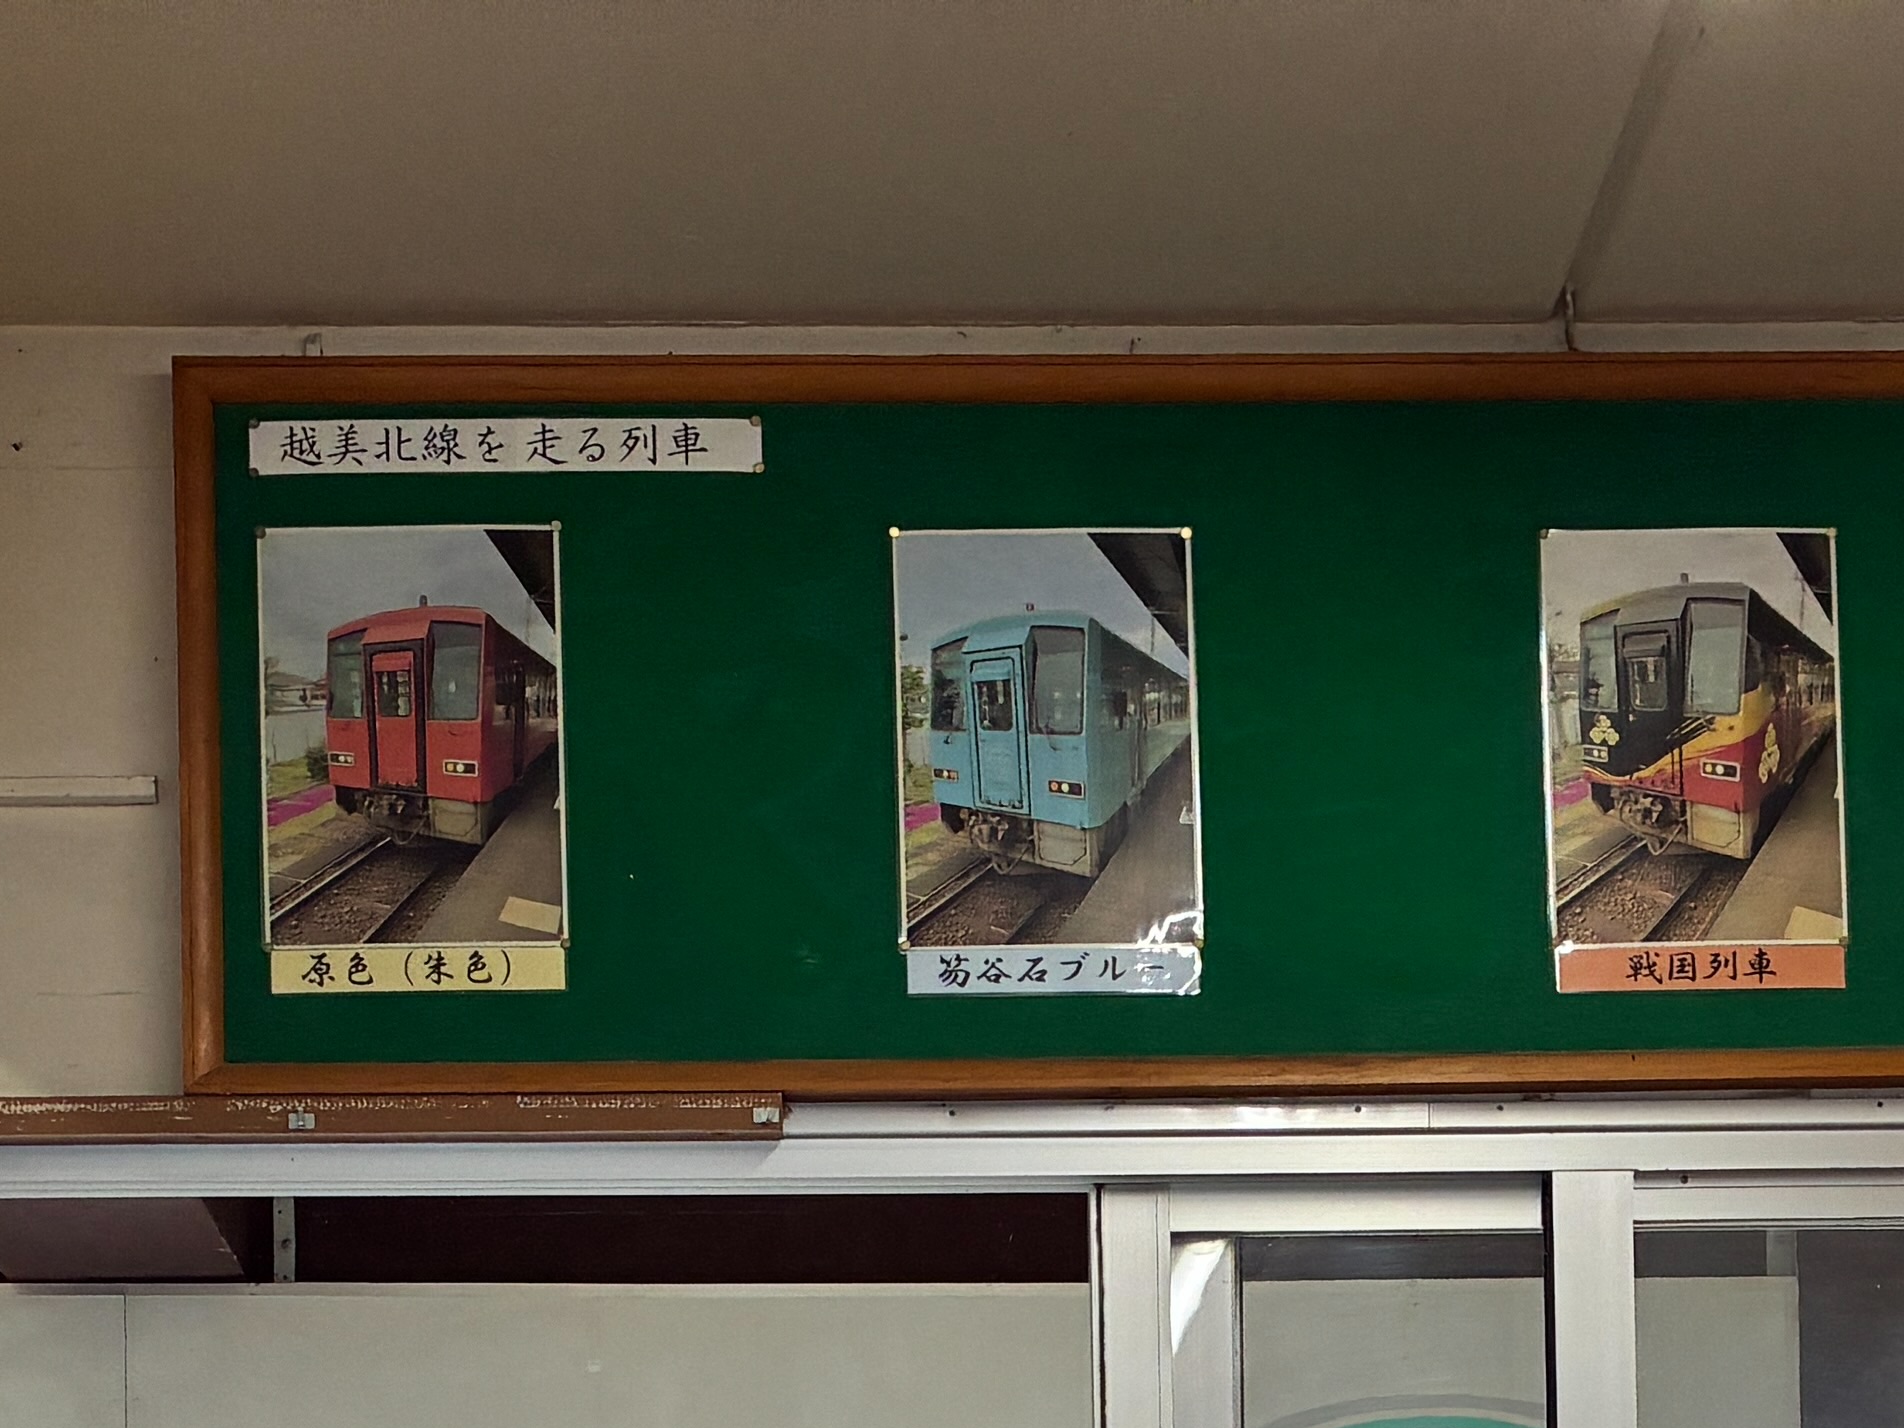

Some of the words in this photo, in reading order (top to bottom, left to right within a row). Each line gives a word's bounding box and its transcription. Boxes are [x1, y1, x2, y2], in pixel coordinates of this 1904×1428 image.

[279, 424, 711, 467] 越美北線を走る列車
[1626, 950, 1778, 984] 戦国列車
